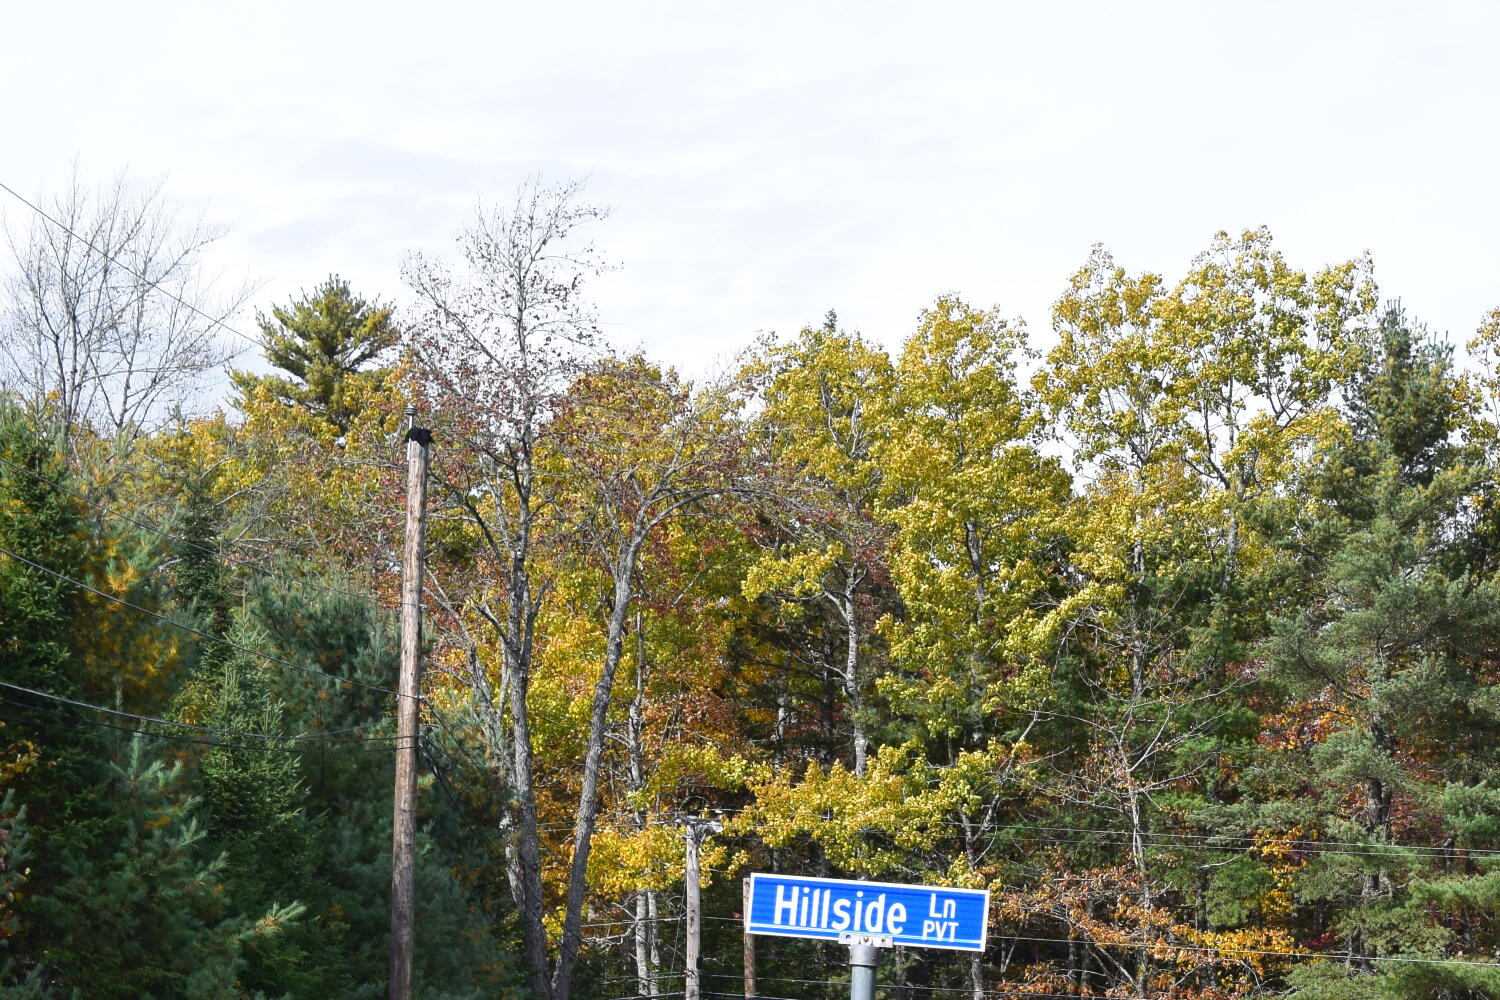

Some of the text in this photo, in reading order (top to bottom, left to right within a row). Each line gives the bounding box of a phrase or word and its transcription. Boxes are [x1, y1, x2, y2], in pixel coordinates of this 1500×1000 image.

[774, 885, 956, 934] Hillside Ln
[922, 921, 959, 942] PVT
